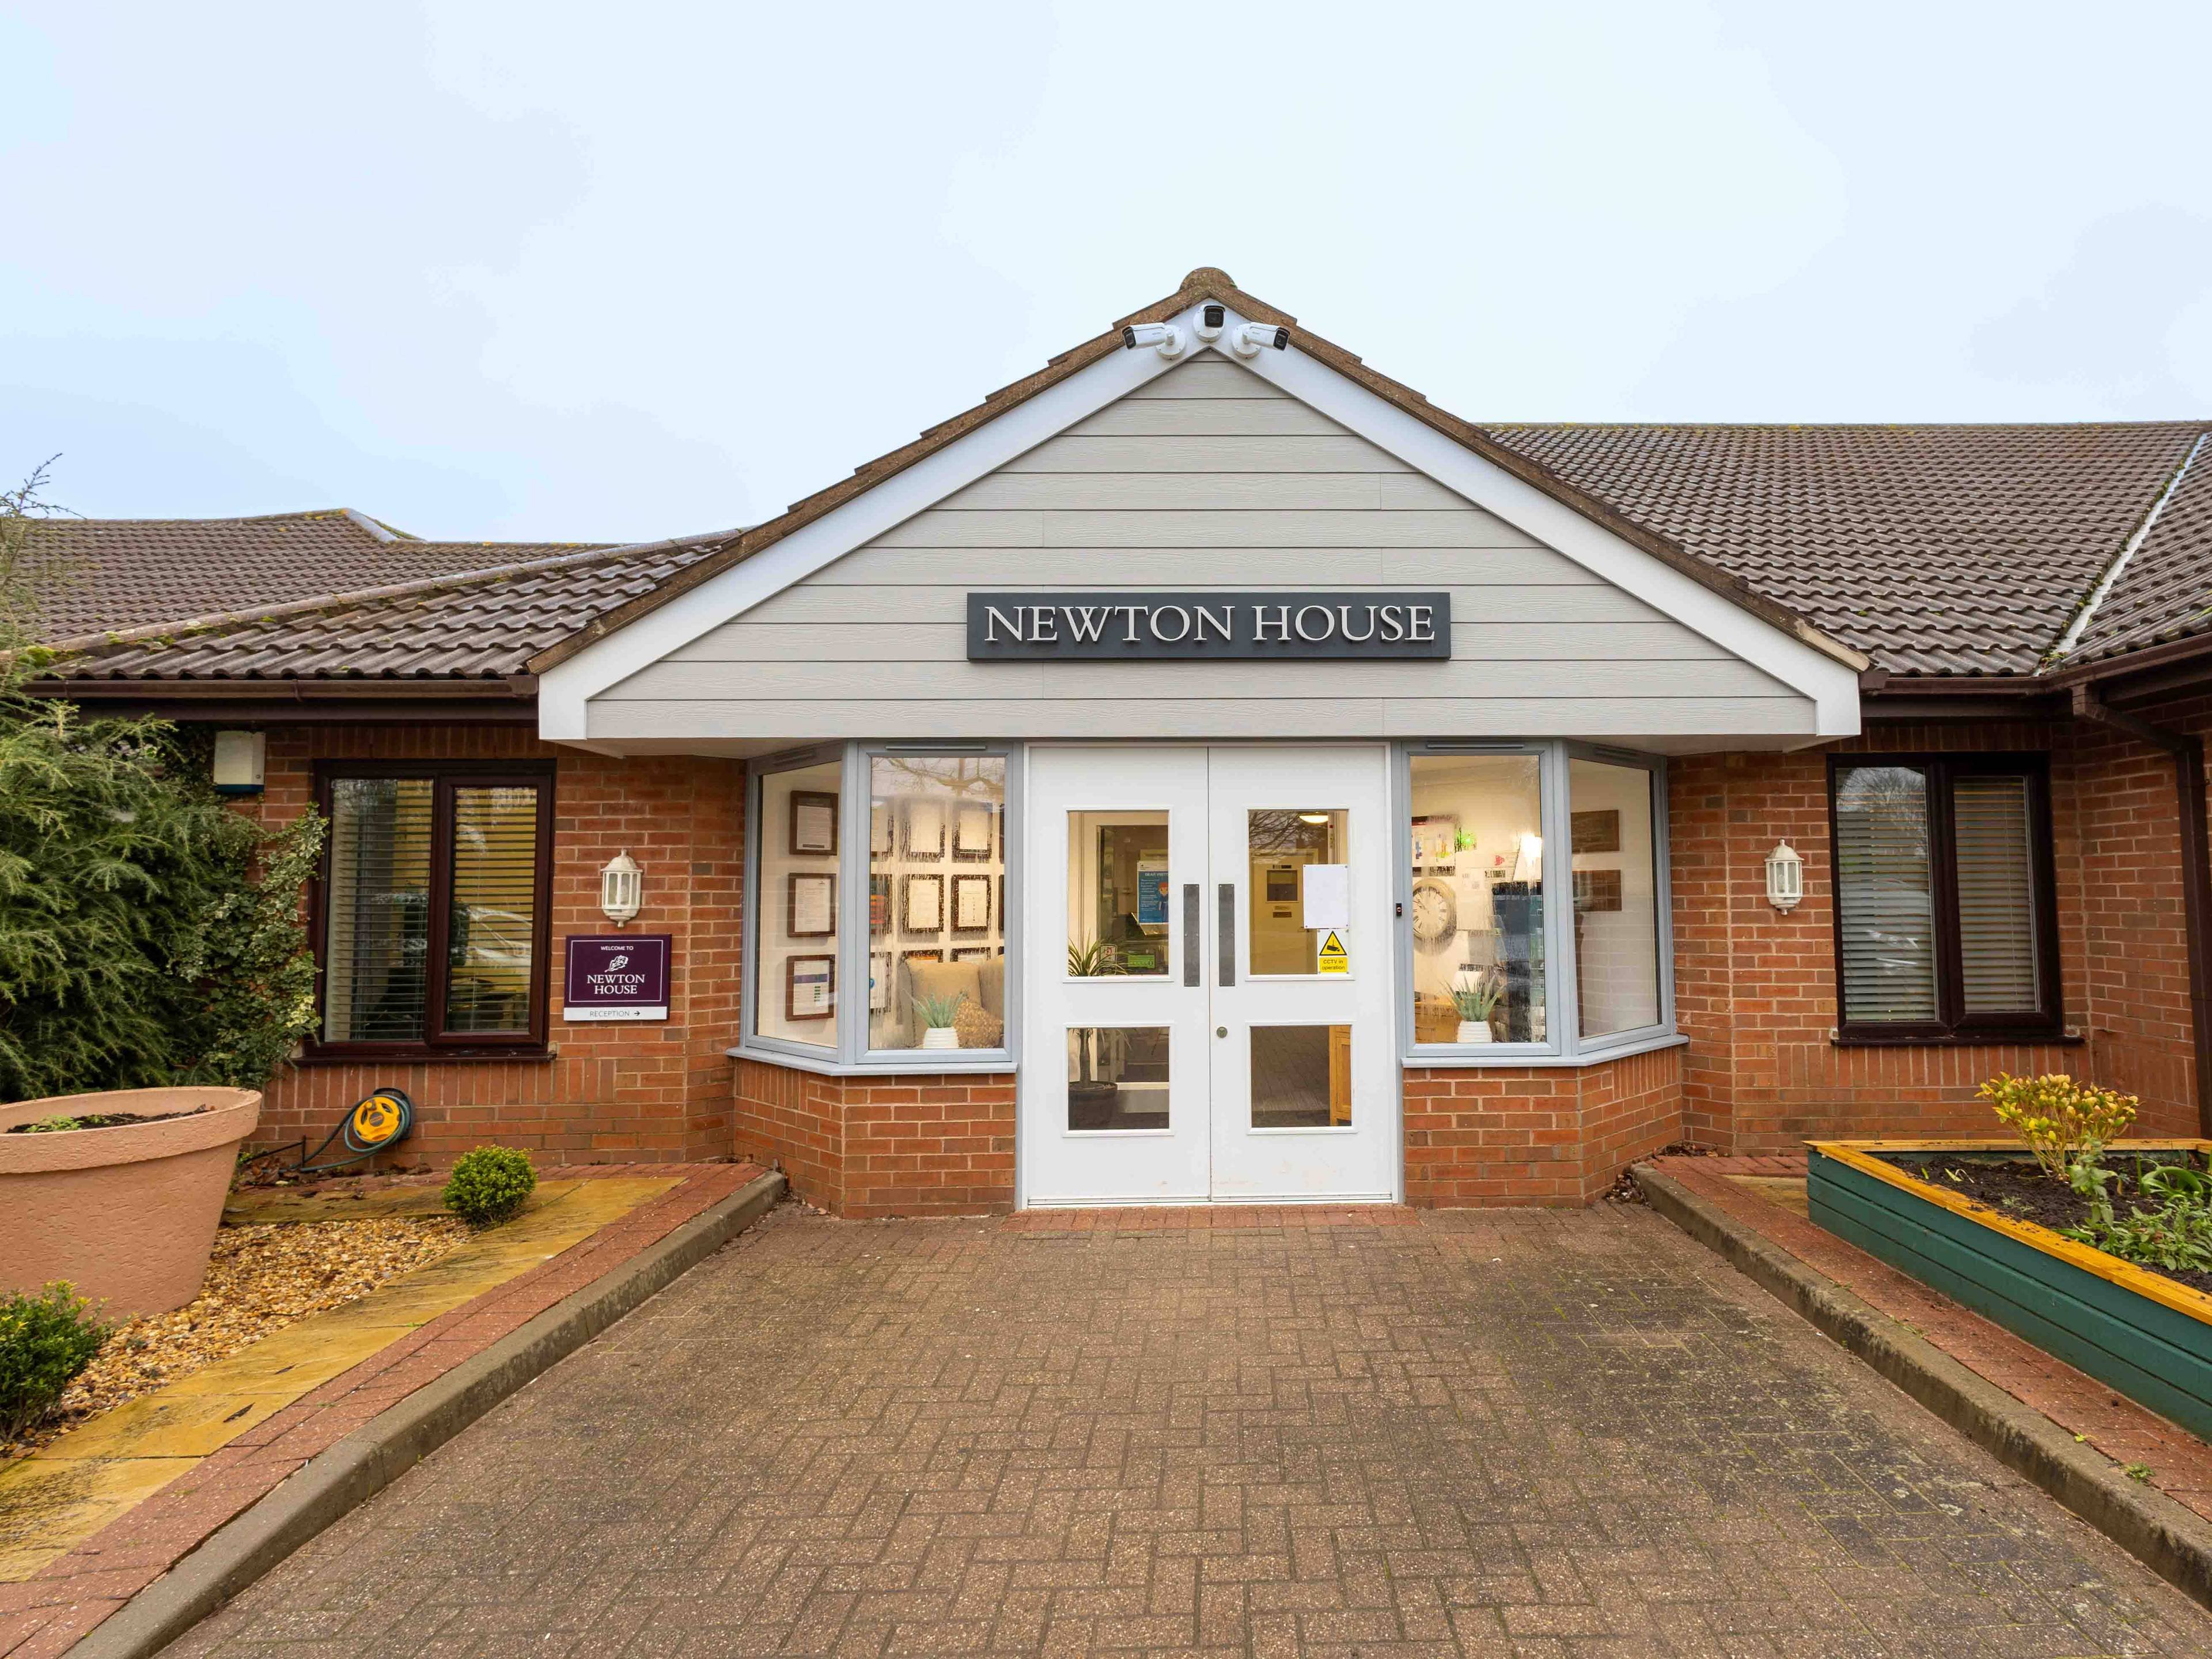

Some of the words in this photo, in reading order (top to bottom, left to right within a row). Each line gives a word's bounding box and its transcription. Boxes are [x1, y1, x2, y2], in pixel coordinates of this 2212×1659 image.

[984, 605, 1234, 642] NEWTON
[1252, 605, 1435, 642] HOUSE
[587, 974, 645, 984] NEWTON
[594, 985, 637, 994] HOUSE
